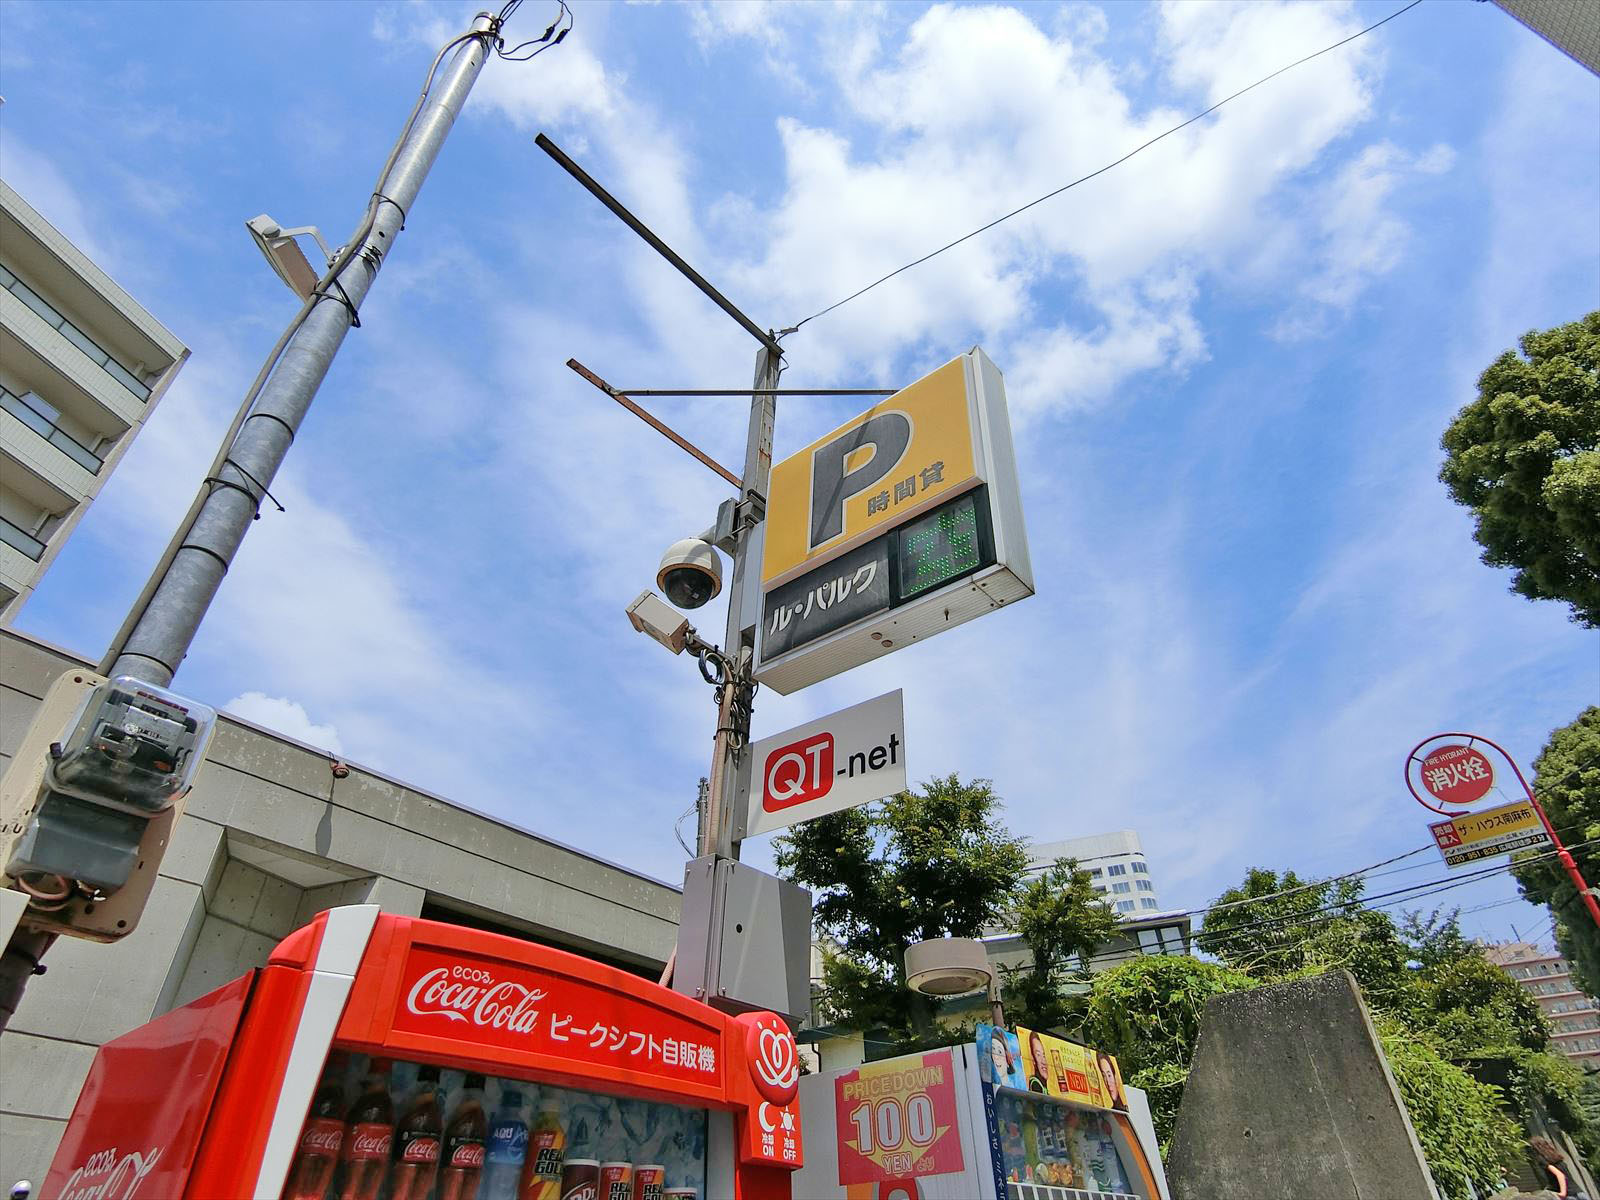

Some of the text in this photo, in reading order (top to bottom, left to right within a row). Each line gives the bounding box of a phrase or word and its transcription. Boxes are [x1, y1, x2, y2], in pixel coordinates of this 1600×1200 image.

[808, 410, 913, 553] P
[868, 461, 944, 517] 時間貸
[769, 560, 878, 636] ル・パルク
[768, 733, 900, 801] QT-net
[1424, 747, 1470, 767] FIRE HYDRANT
[1424, 756, 1490, 792] 消火栓
[1457, 808, 1532, 836] ザ・ハウス南麻布
[407, 967, 548, 1034] Coca-Cola
[550, 1012, 716, 1073] ピークシフト自販機
[843, 1065, 945, 1102] PRICE DOWN
[850, 1091, 937, 1157] 100
[763, 1144, 774, 1157] ON
[783, 1148, 797, 1161] OFF
[881, 1152, 913, 1175] YEN
